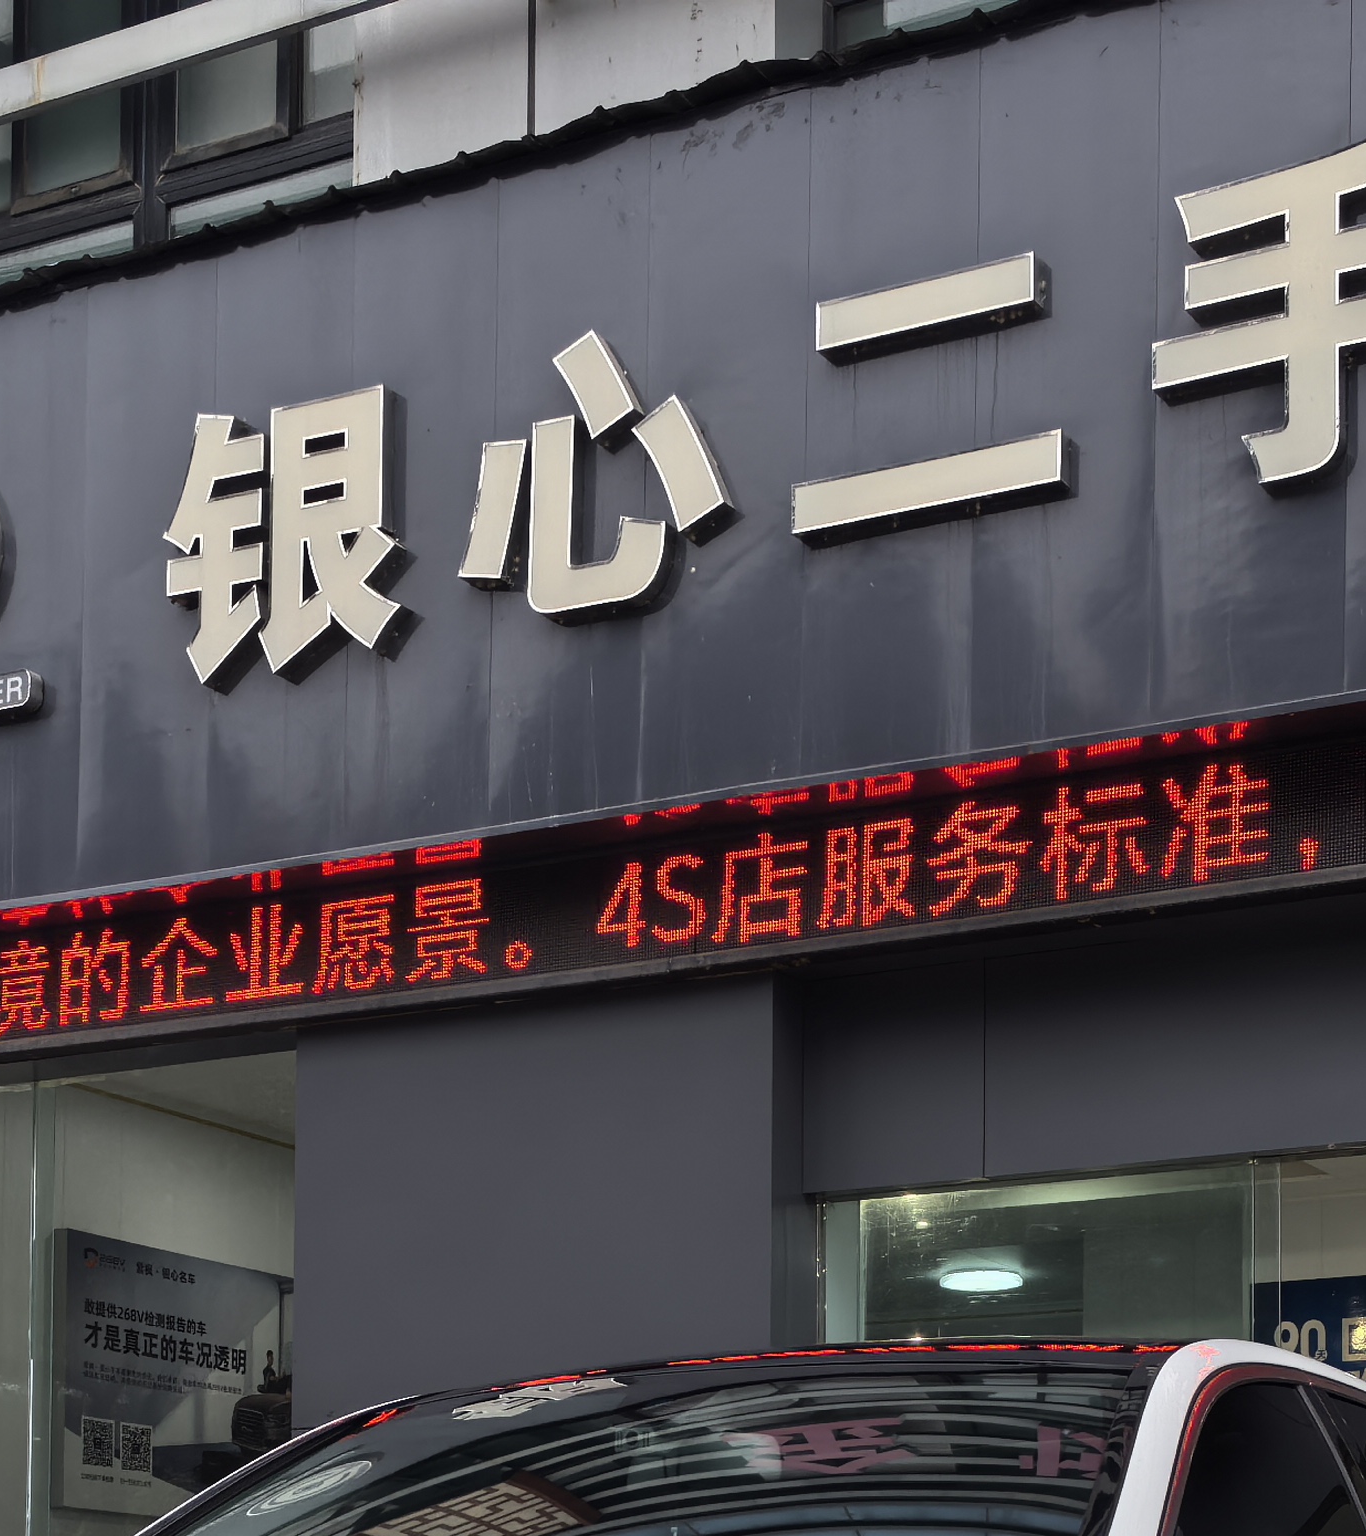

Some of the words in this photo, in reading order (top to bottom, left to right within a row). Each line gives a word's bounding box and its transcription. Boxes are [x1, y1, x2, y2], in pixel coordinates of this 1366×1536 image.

[83, 1321, 248, 1375] 才是真正的车况透明
